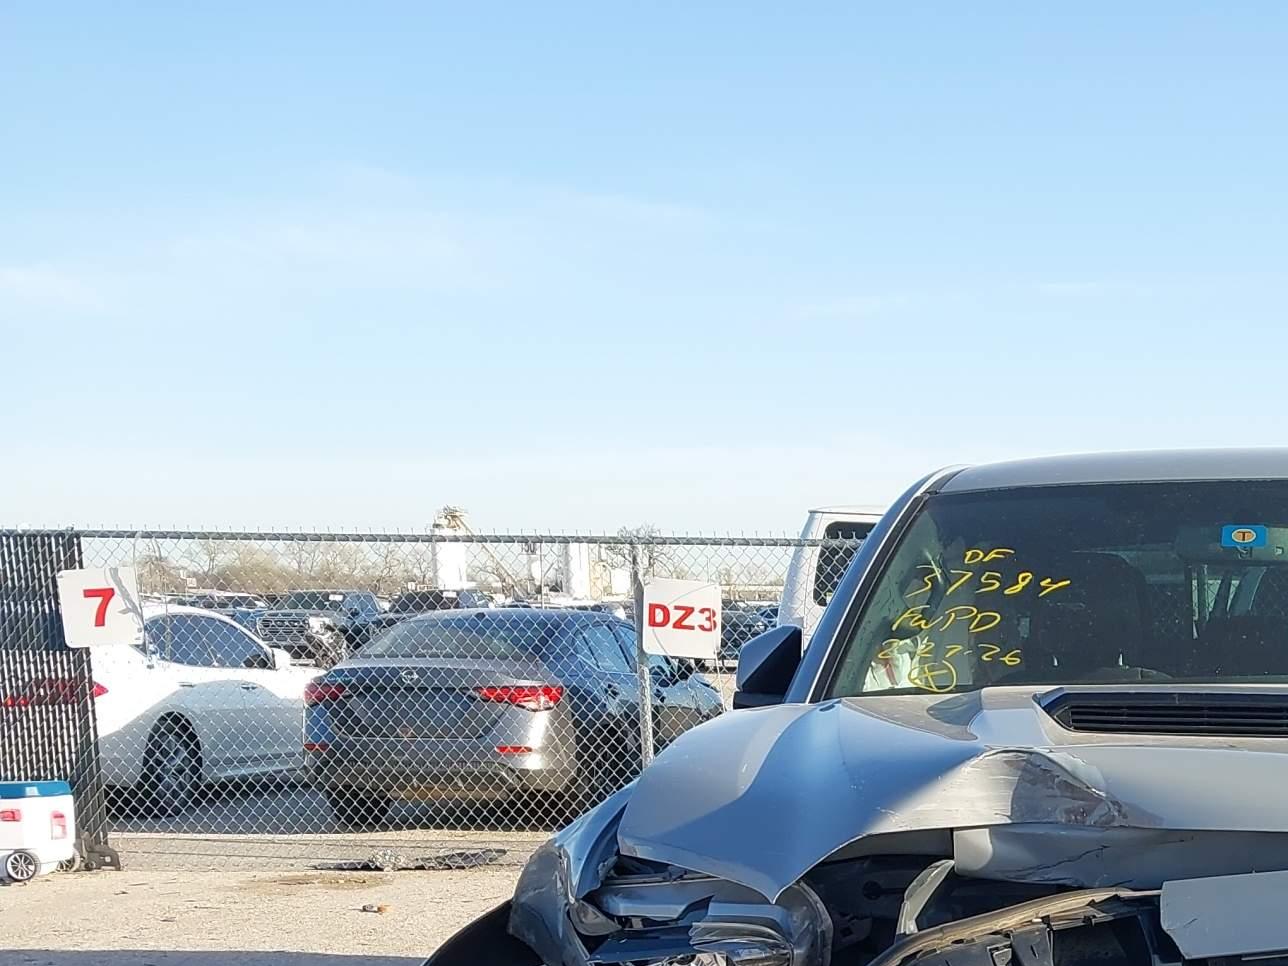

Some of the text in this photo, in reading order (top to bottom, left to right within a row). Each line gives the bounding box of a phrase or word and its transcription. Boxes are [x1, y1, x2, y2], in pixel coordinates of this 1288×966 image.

[905, 562, 1071, 598] 37584
[83, 587, 115, 628] 7
[648, 602, 717, 632] DZ3
